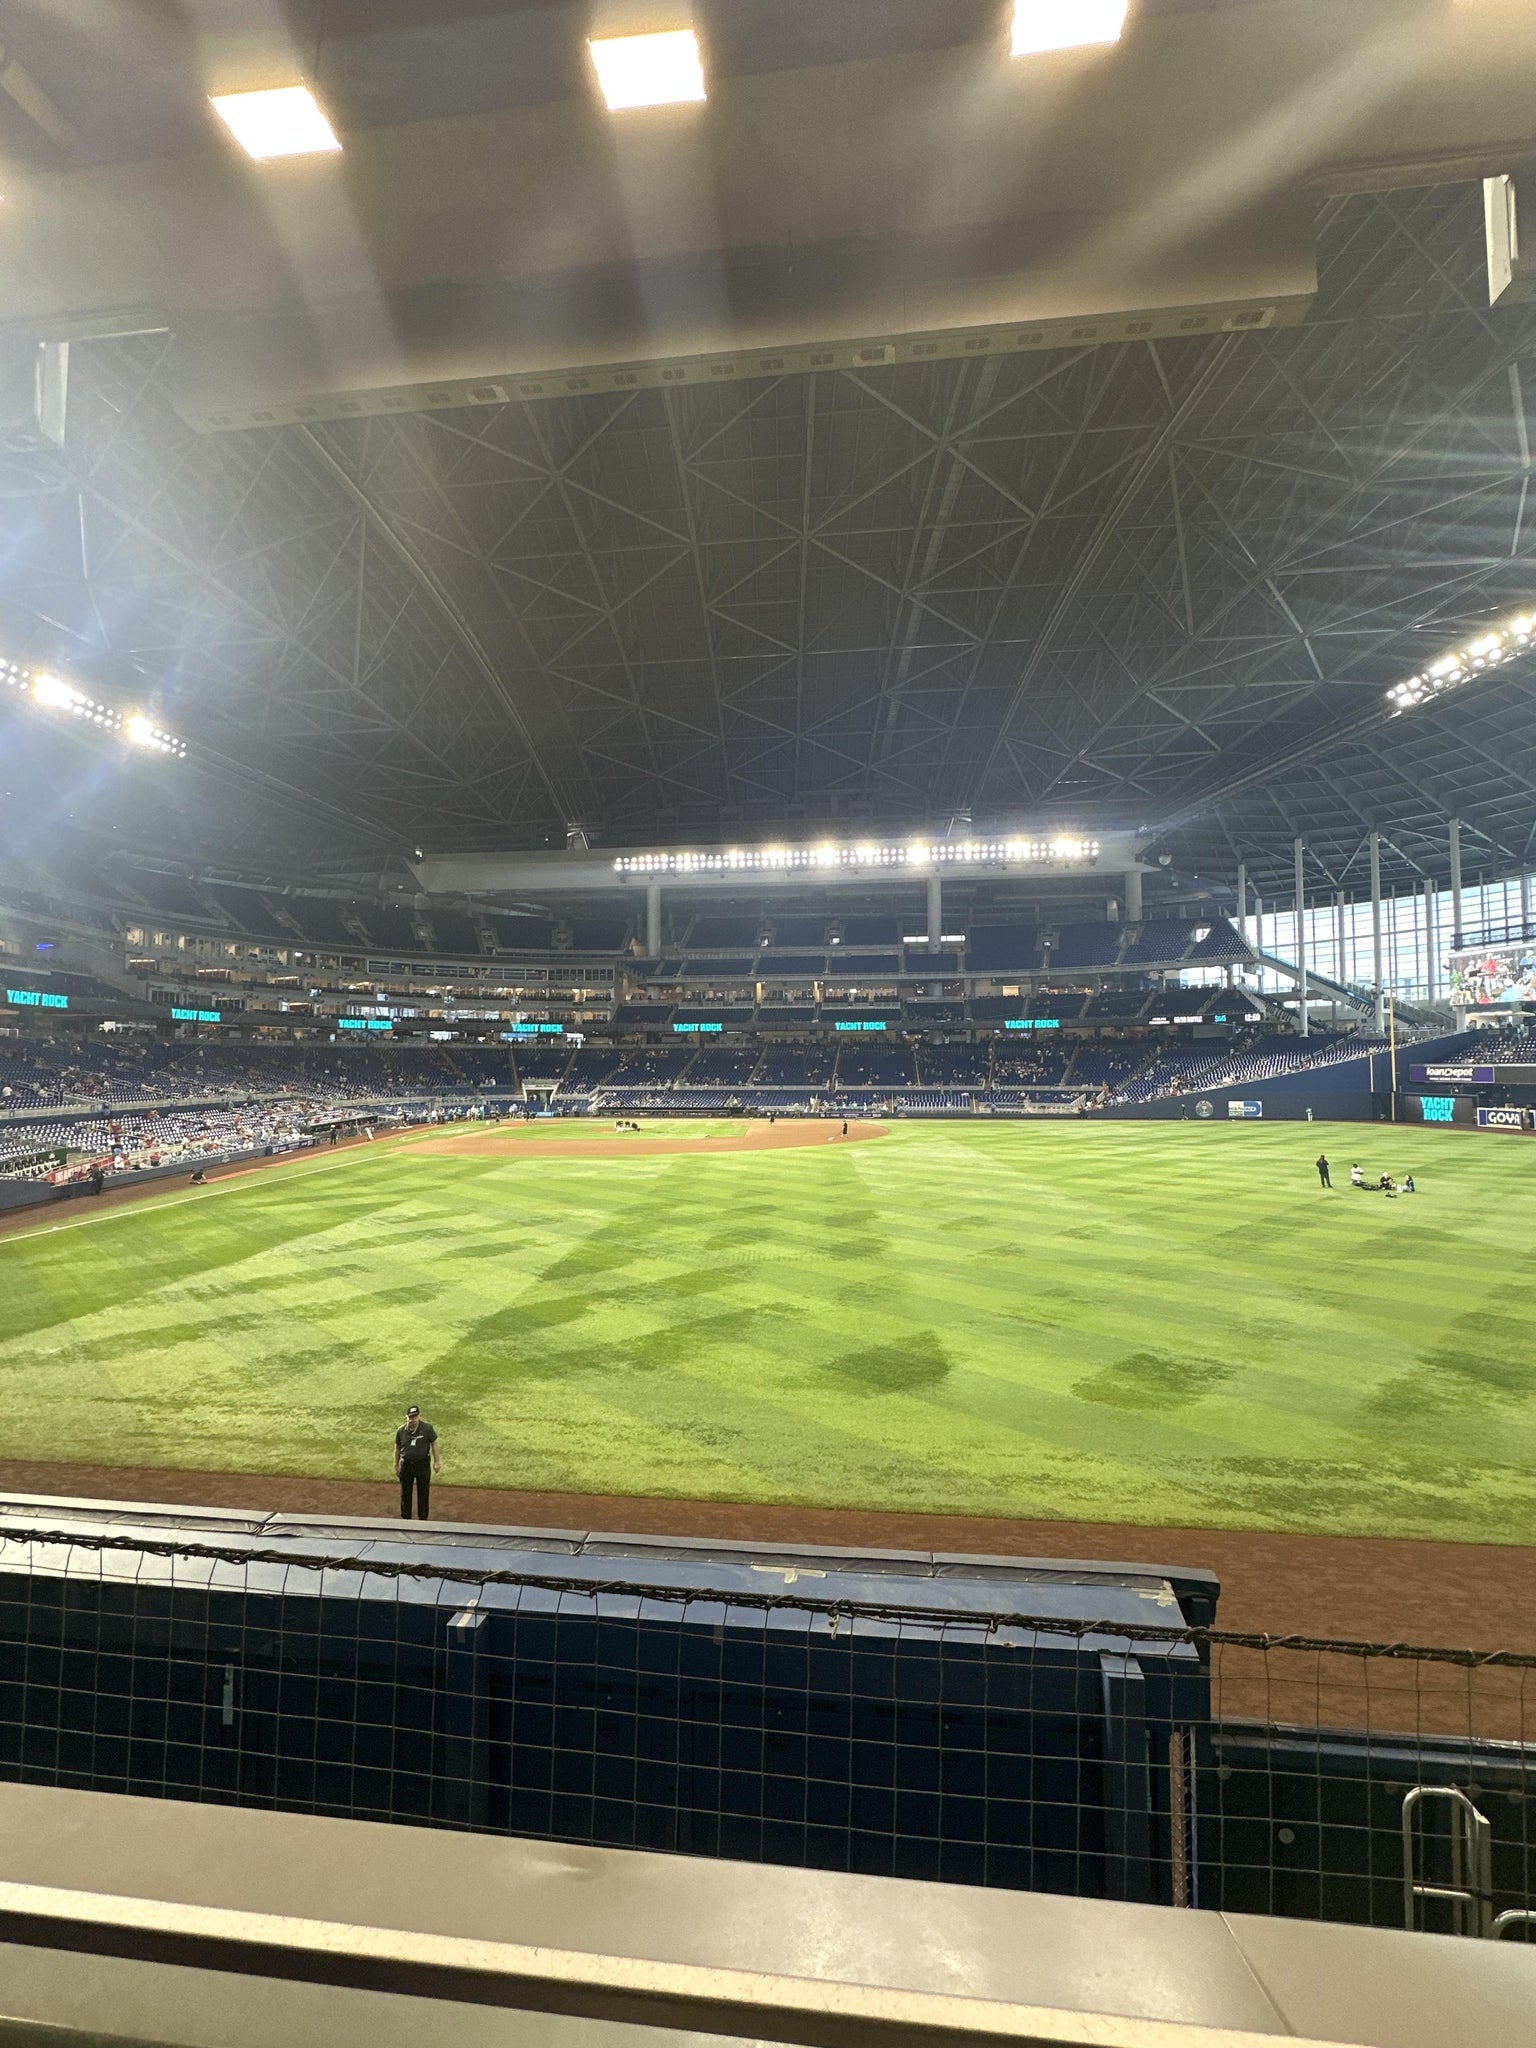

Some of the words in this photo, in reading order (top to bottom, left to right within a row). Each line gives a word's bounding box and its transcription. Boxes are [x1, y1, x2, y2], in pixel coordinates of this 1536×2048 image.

[7, 989, 41, 1005] YACHT
[42, 993, 68, 1008] ROCK
[171, 1008, 198, 1020] YACHT
[198, 1010, 221, 1022] ROCK
[339, 1019, 367, 1029] YACHT
[368, 1020, 393, 1029] ROCK
[512, 1023, 539, 1032] YACHT
[540, 1023, 563, 1032] ROCK
[673, 1023, 699, 1032] YACHT
[700, 1023, 722, 1032] ROCK
[835, 1022, 863, 1030] YACHT
[863, 1021, 886, 1030] ROCK
[1004, 1020, 1033, 1029] YACHT
[1035, 1019, 1059, 1028] ROCK
[1426, 1067, 1473, 1078] loanDepot
[1420, 1097, 1455, 1109] YACHT
[1423, 1109, 1453, 1121] ROCK
[1488, 1112, 1520, 1125] GOYA
